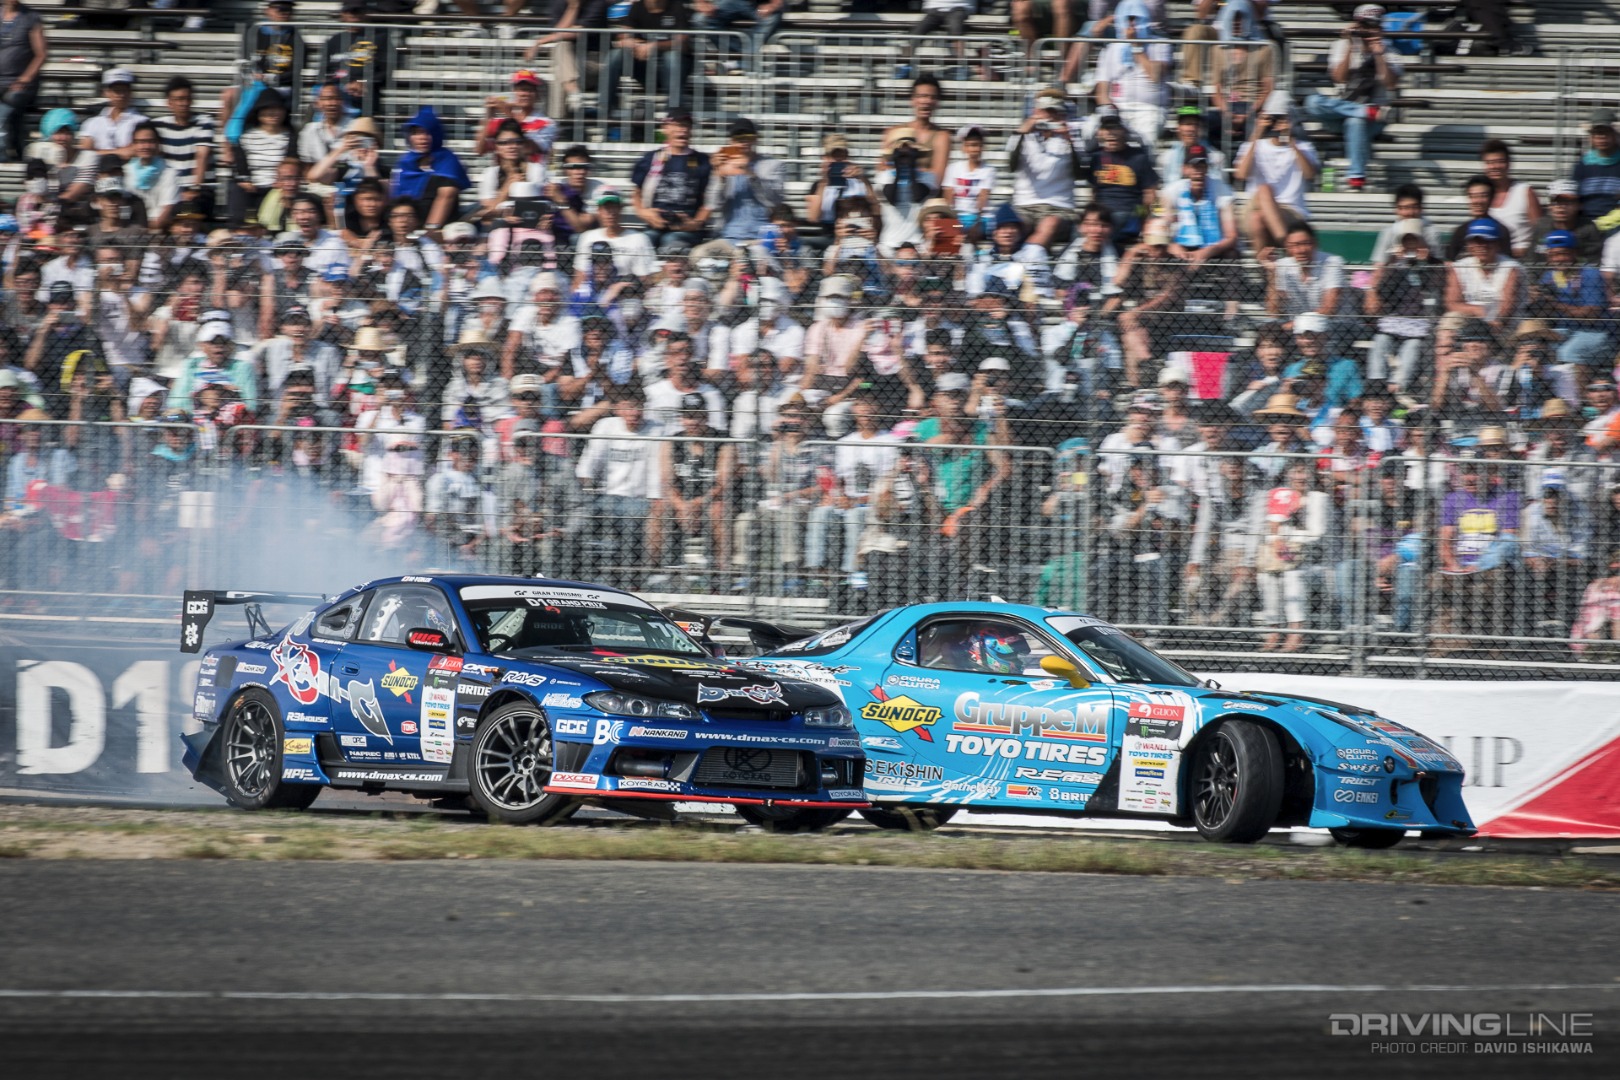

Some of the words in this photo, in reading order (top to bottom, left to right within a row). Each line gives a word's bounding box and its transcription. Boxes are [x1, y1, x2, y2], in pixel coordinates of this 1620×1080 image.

[187, 601, 208, 614] GCG
[383, 675, 418, 688] SUNOCO
[503, 671, 546, 686] RAYS
[824, 678, 851, 686] SYSTEM
[900, 676, 941, 684] OGURA
[457, 684, 492, 697] BRIDE
[899, 681, 940, 690] CLUTCH
[865, 703, 938, 723] SUNOCO
[953, 690, 1110, 736] GruppeM
[1152, 707, 1179, 717] GLION
[402, 724, 417, 732] TONE
[556, 719, 589, 735] GCG
[642, 730, 686, 740] NANKANG
[694, 732, 826, 746] www.dmax-cs.com
[945, 733, 1023, 759] TOYO
[1023, 741, 1109, 767] TIRES
[1142, 743, 1168, 751] WANLI
[1150, 752, 1173, 760] TIRES
[1337, 761, 1381, 773] Swift
[337, 769, 443, 782] www.dmax-cs.com
[552, 774, 597, 784] DIXCEL
[872, 773, 930, 788] TRUST
[1337, 776, 1381, 787] TRUST
[620, 779, 667, 790] KOYORAD
[830, 790, 861, 799] KOYORAD
[1060, 791, 1092, 803] BRI
[1355, 791, 1379, 804] ENKEI
